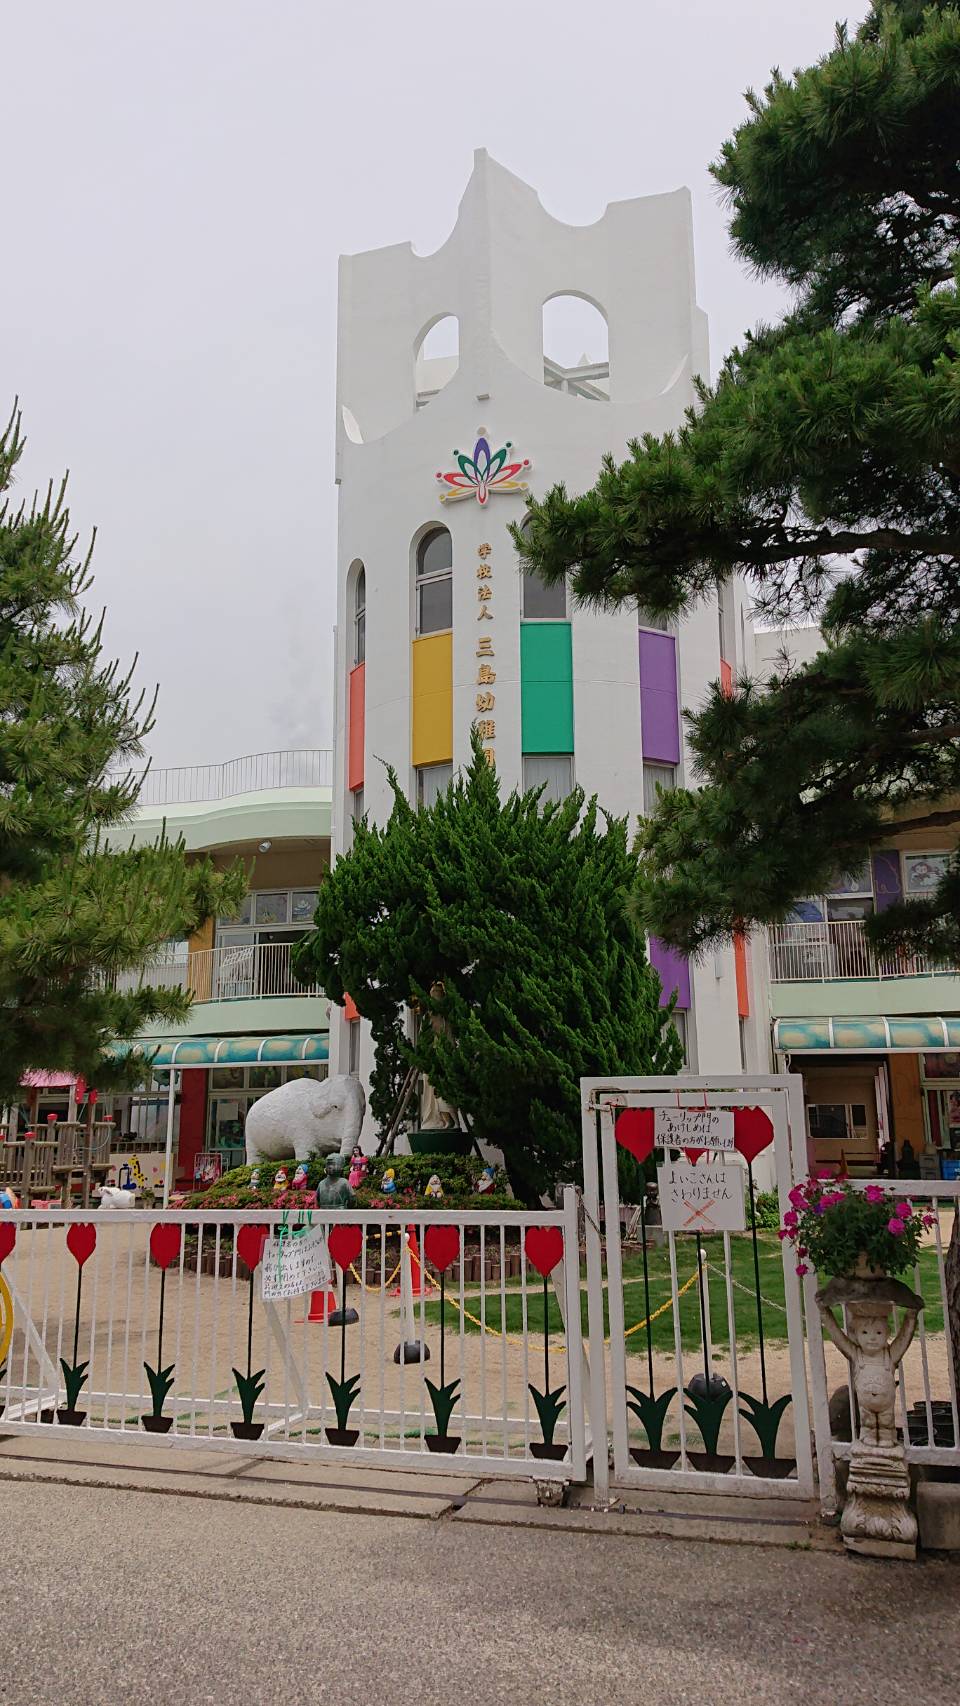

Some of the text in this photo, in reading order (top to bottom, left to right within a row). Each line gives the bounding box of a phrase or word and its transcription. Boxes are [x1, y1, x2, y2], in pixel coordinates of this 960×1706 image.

[476, 543, 493, 621] 学校法人
[659, 1110, 719, 1124] チューリップ門の
[667, 1122, 711, 1133] あけしめは
[669, 1171, 726, 1184] よいこさんは
[671, 1187, 732, 1203] さわりません
